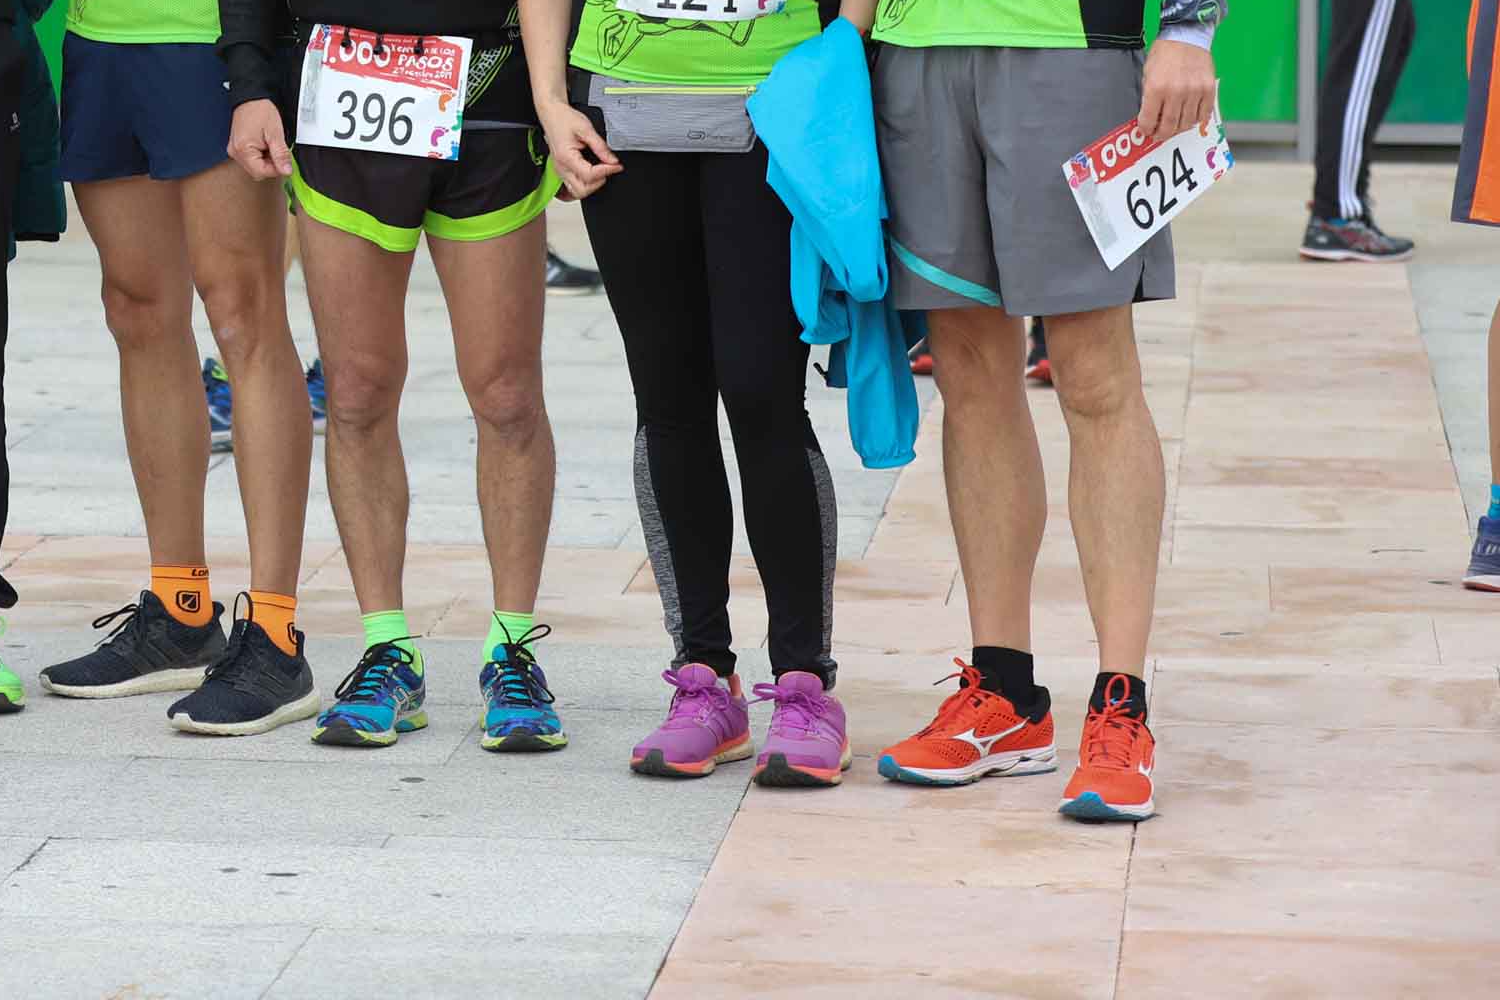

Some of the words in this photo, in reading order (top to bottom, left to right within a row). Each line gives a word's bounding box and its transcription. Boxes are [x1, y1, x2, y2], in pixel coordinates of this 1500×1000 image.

[398, 54, 454, 70] PASOS
[334, 90, 416, 146] 396
[1126, 147, 1198, 230] 624
